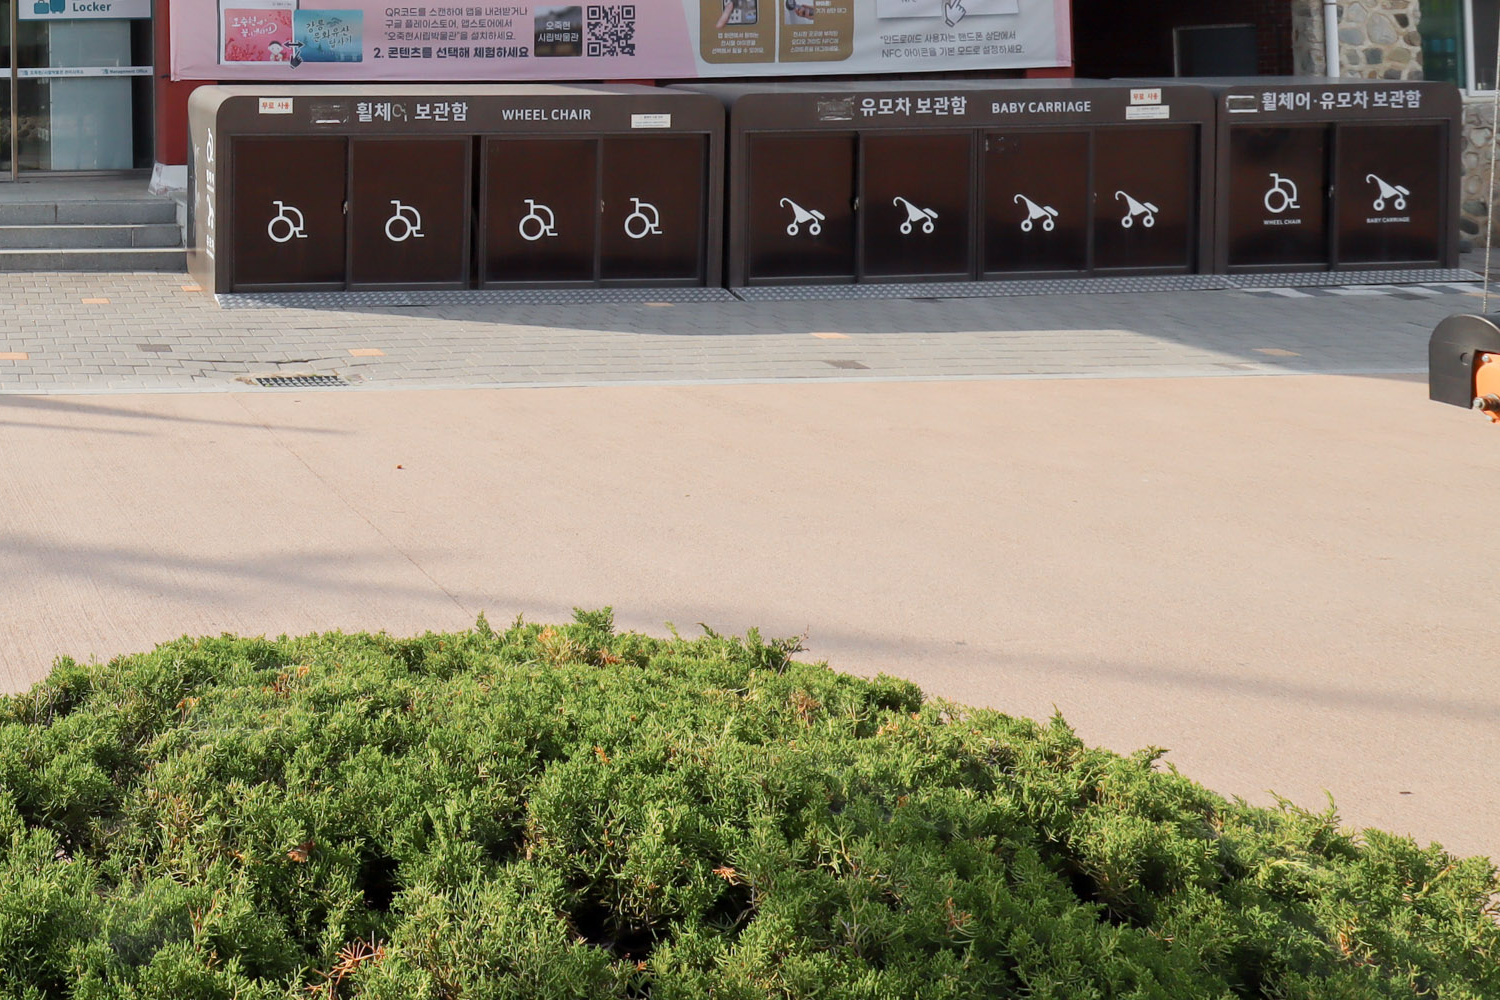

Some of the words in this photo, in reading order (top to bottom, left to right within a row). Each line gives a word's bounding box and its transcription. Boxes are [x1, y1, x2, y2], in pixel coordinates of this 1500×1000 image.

[72, 1, 112, 13] Locker
[385, 7, 426, 17] QR코드를
[428, 7, 463, 17] 스캔하여
[485, 7, 528, 17] 내려받거나
[385, 19, 403, 29] 구글
[461, 19, 513, 29] 앱스토어에서
[545, 21, 571, 30] 오죽헌
[537, 32, 580, 42] 시립박물관
[373, 47, 385, 59] 2.
[387, 46, 433, 59] 콘텐츠를
[436, 46, 470, 58] 선택해
[473, 46, 530, 59] 체험하세요
[881, 49, 902, 58] NFC
[1373, 90, 1422, 109] 보관함
[261, 102, 275, 110] 무료
[414, 102, 469, 122] 보관함
[859, 97, 912, 117] 유모차
[915, 96, 968, 116] 보관함
[991, 102, 1027, 114] BABY
[1028, 101, 1092, 113] CARRIAGE
[502, 108, 549, 121] WHEEL
[551, 108, 592, 120] CHAIR
